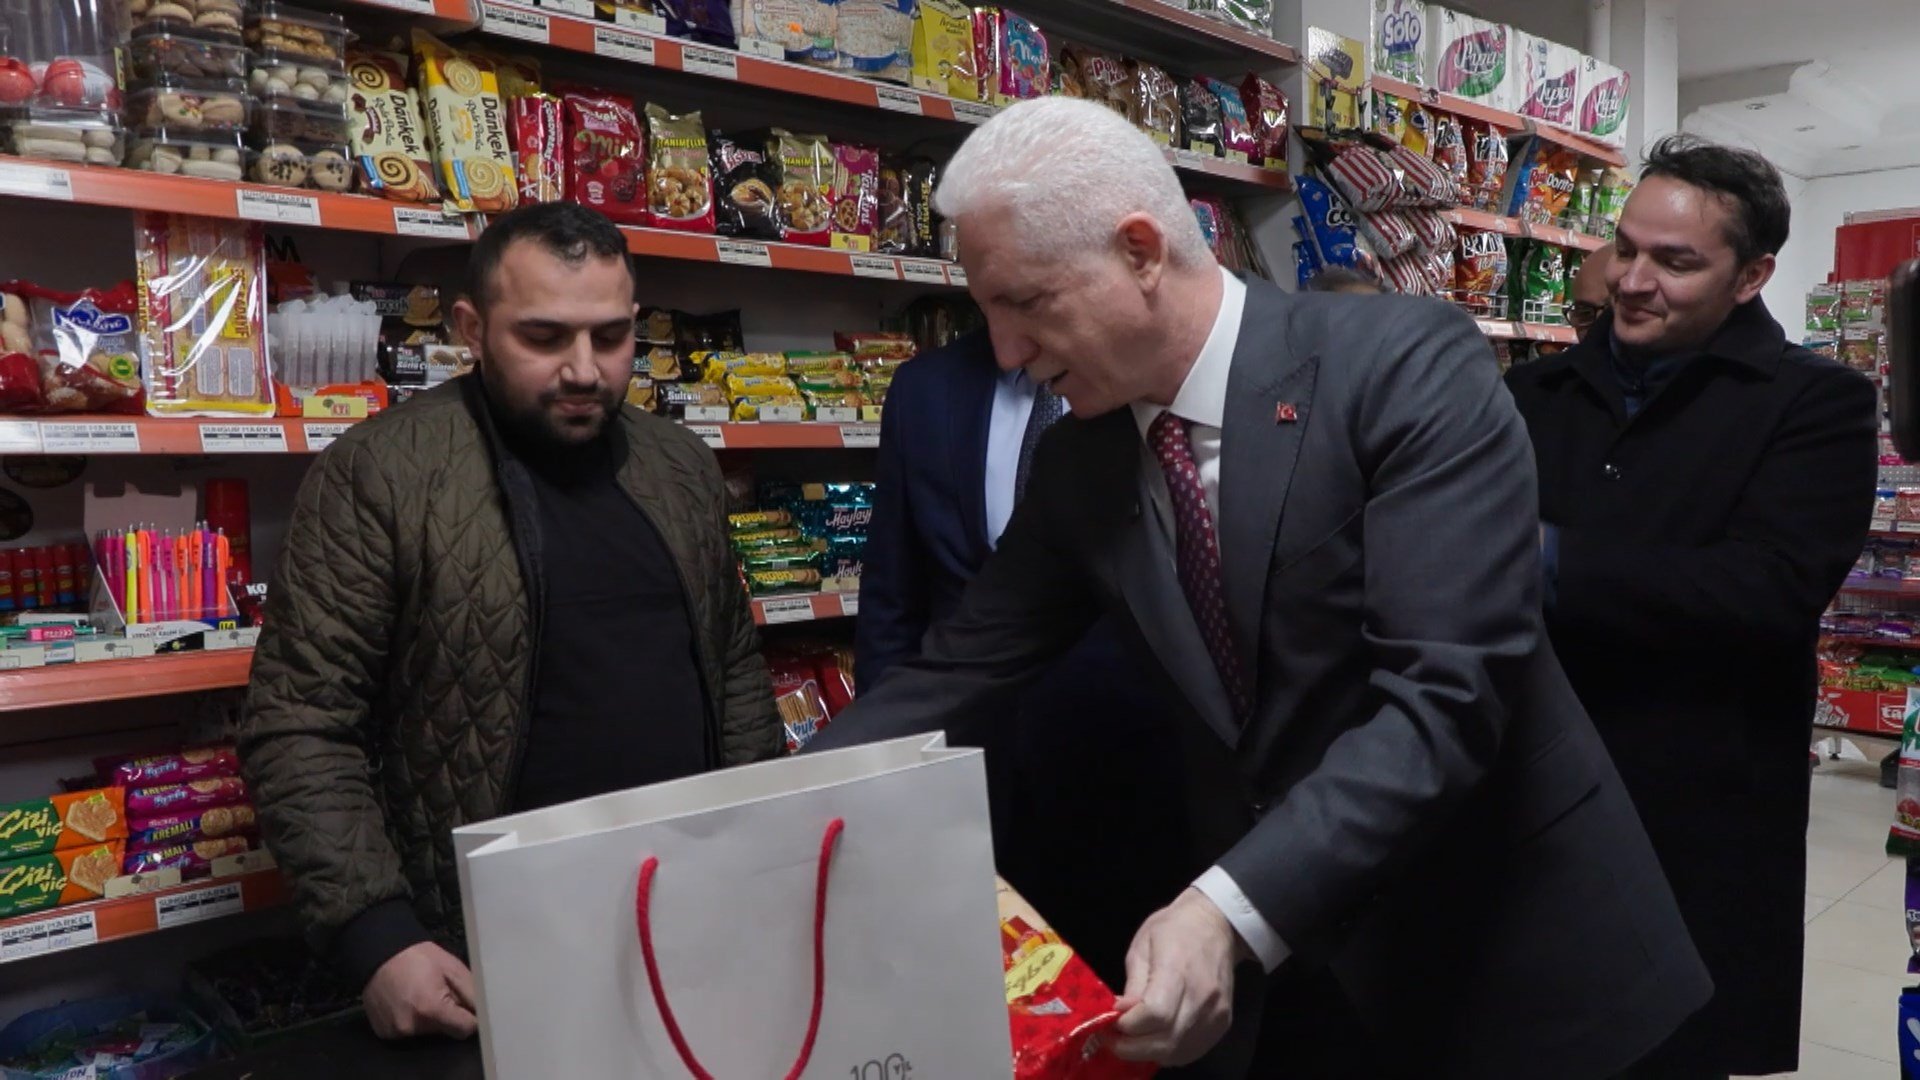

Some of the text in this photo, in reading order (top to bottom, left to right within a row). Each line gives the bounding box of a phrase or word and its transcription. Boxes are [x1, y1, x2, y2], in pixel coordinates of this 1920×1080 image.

[390, 94, 421, 154] Dankek
[481, 96, 504, 160] Dankek
[1547, 171, 1575, 193] Dorito
[152, 820, 194, 841] KREMALI
[146, 845, 187, 864] KEMALI
